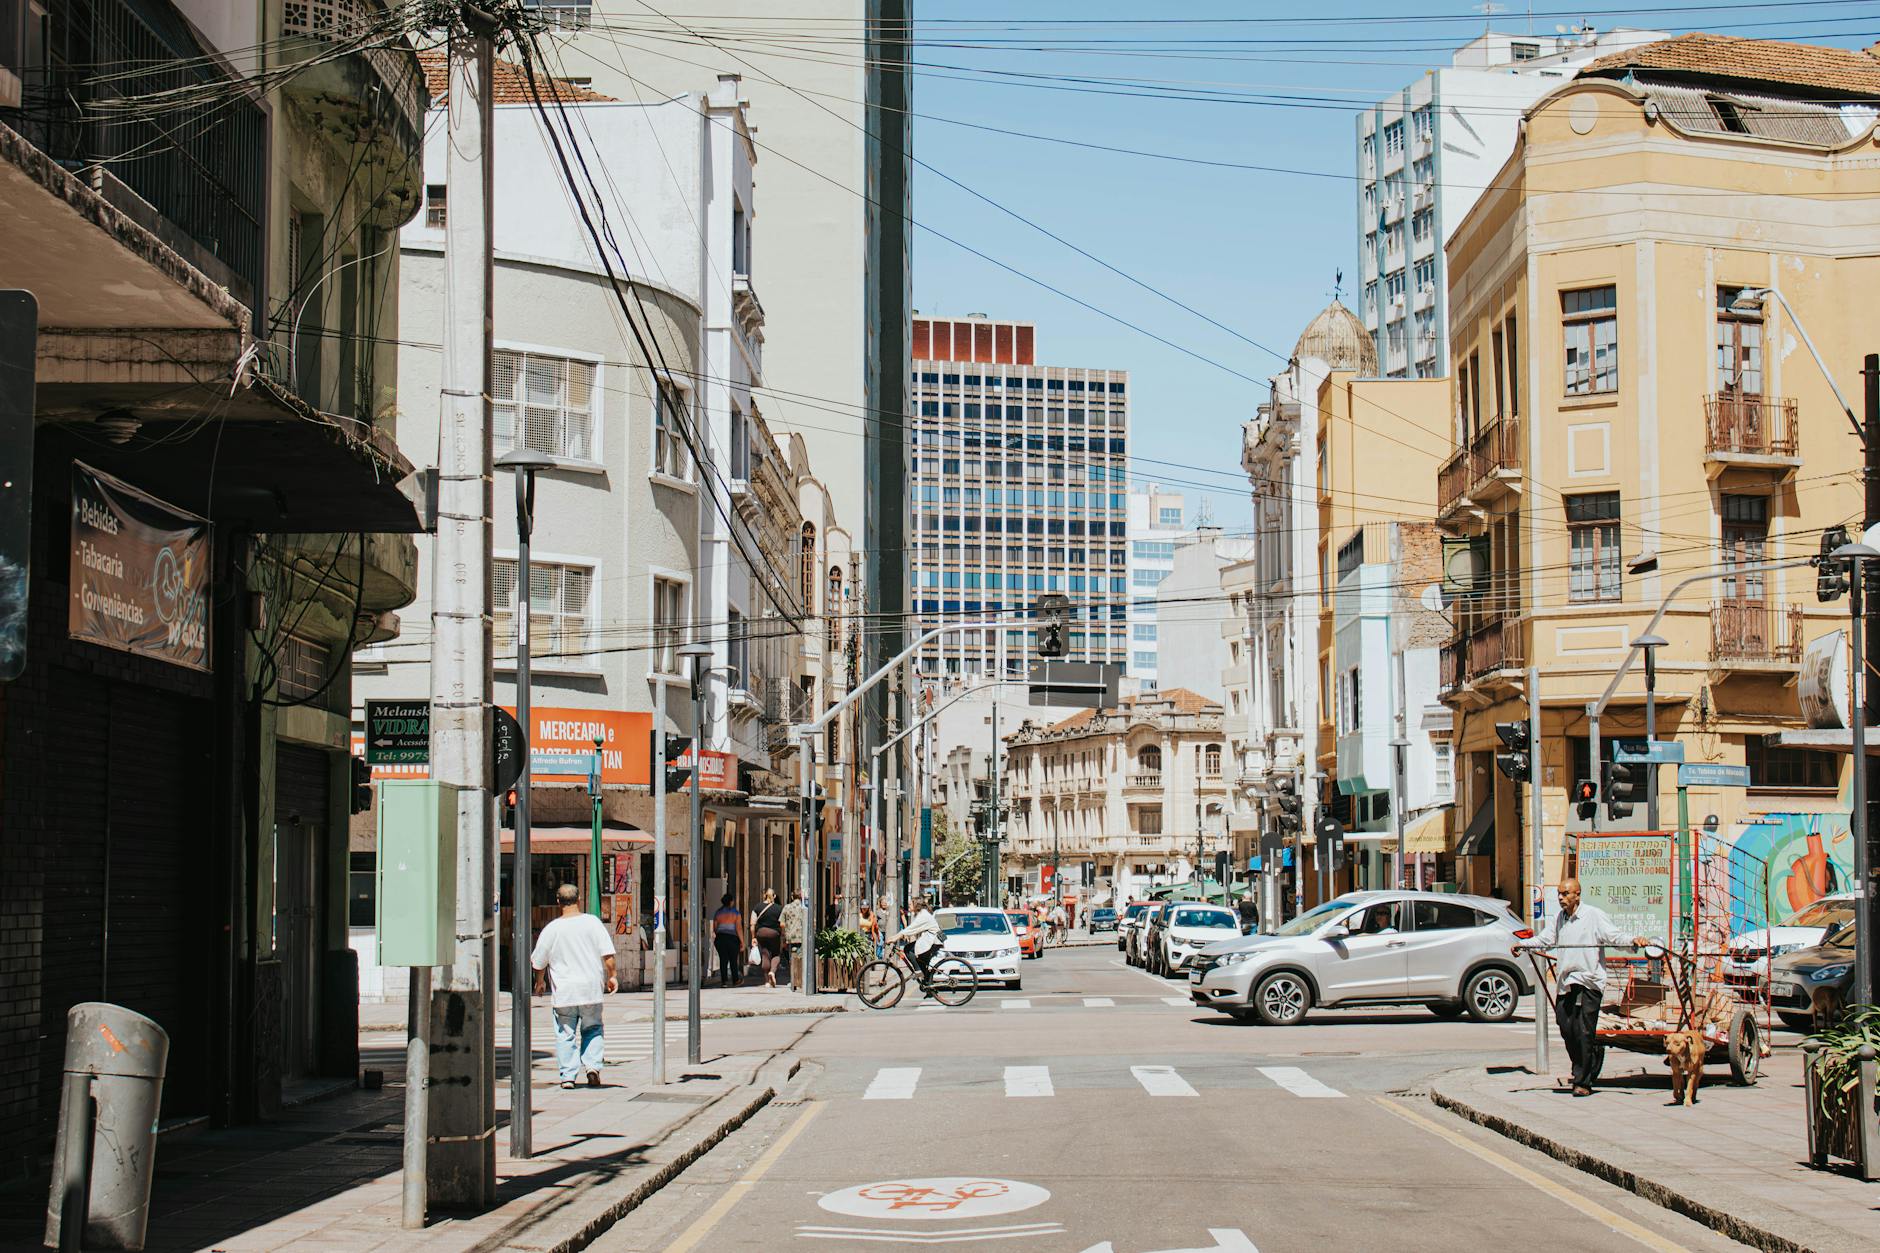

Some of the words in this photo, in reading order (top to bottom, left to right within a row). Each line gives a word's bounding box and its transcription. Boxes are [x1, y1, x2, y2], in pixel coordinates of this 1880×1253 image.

[81, 498, 119, 535] Bebidas
[80, 540, 123, 579] Tabacaria
[81, 583, 144, 625] Conveniências
[374, 706, 430, 717] Melansk
[372, 719, 430, 735] VIDRA
[539, 720, 607, 742] MERCEARIA
[608, 727, 615, 743] e
[375, 751, 397, 760] Tel:
[400, 751, 430, 761] 9975
